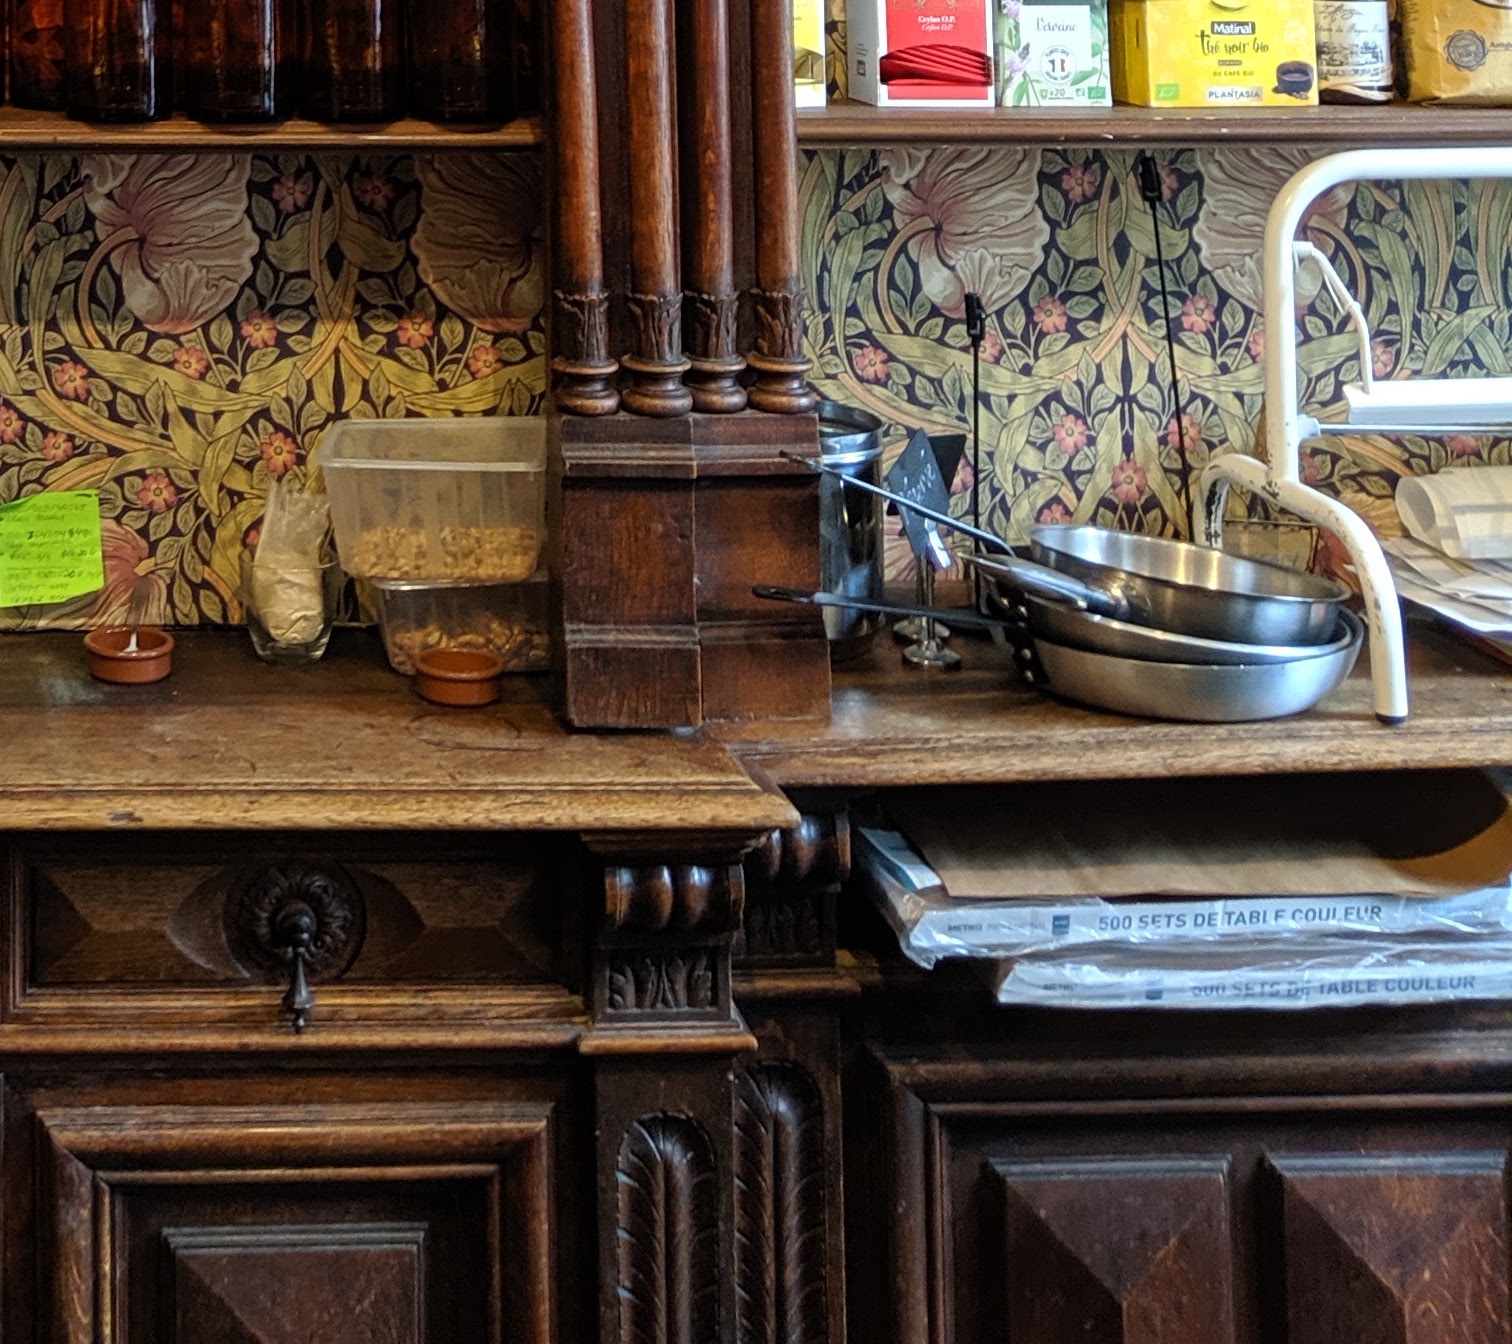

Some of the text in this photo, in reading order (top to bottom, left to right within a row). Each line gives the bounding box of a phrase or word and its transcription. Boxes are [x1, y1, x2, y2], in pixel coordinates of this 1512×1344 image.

[1213, 22, 1252, 34] Matinal
[1195, 29, 1270, 57] thé noir bio
[1208, 87, 1261, 101] PLANTASIA
[1098, 914, 1132, 932] 500
[1139, 912, 1187, 929] SETS
[1193, 911, 1218, 928] DE
[1224, 908, 1286, 927] TABLE
[1291, 904, 1383, 924] COULEUR
[1318, 978, 1379, 995] TABLE
[1383, 974, 1475, 993] COULEUR
